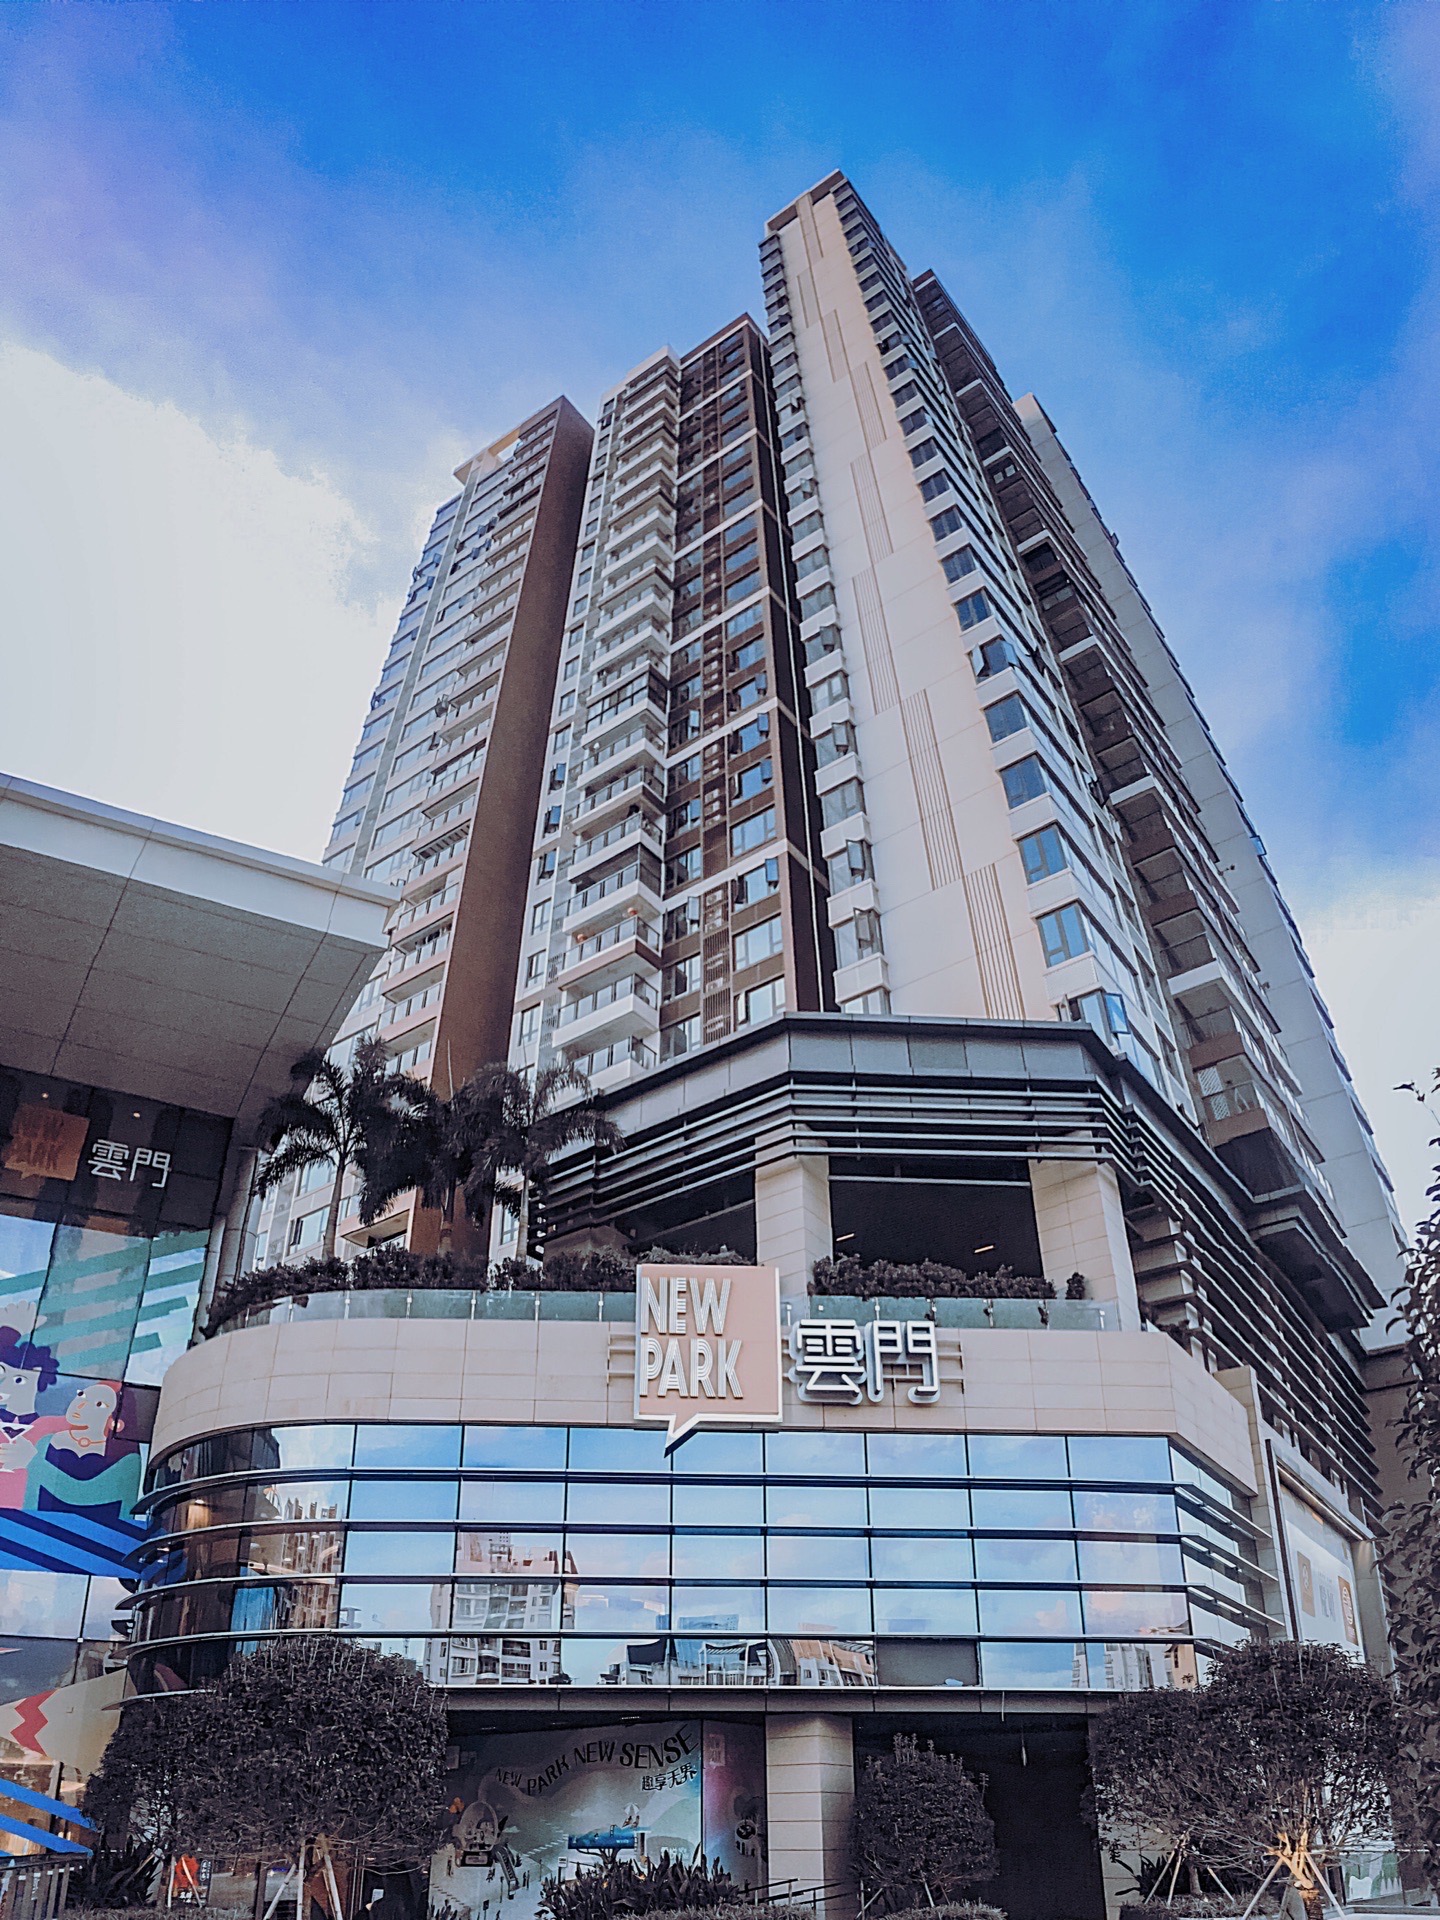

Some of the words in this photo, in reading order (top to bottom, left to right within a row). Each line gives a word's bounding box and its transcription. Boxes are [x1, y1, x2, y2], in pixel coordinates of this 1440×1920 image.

[88, 1139, 171, 1188] 雲門
[640, 1277, 732, 1335] NEW
[639, 1338, 744, 1399] PARK
[794, 1319, 940, 1402] 雲門
[495, 1768, 522, 1788] NEW
[527, 1754, 570, 1796] PARK
[574, 1740, 616, 1766] NEW
[619, 1723, 699, 1769] SENSE
